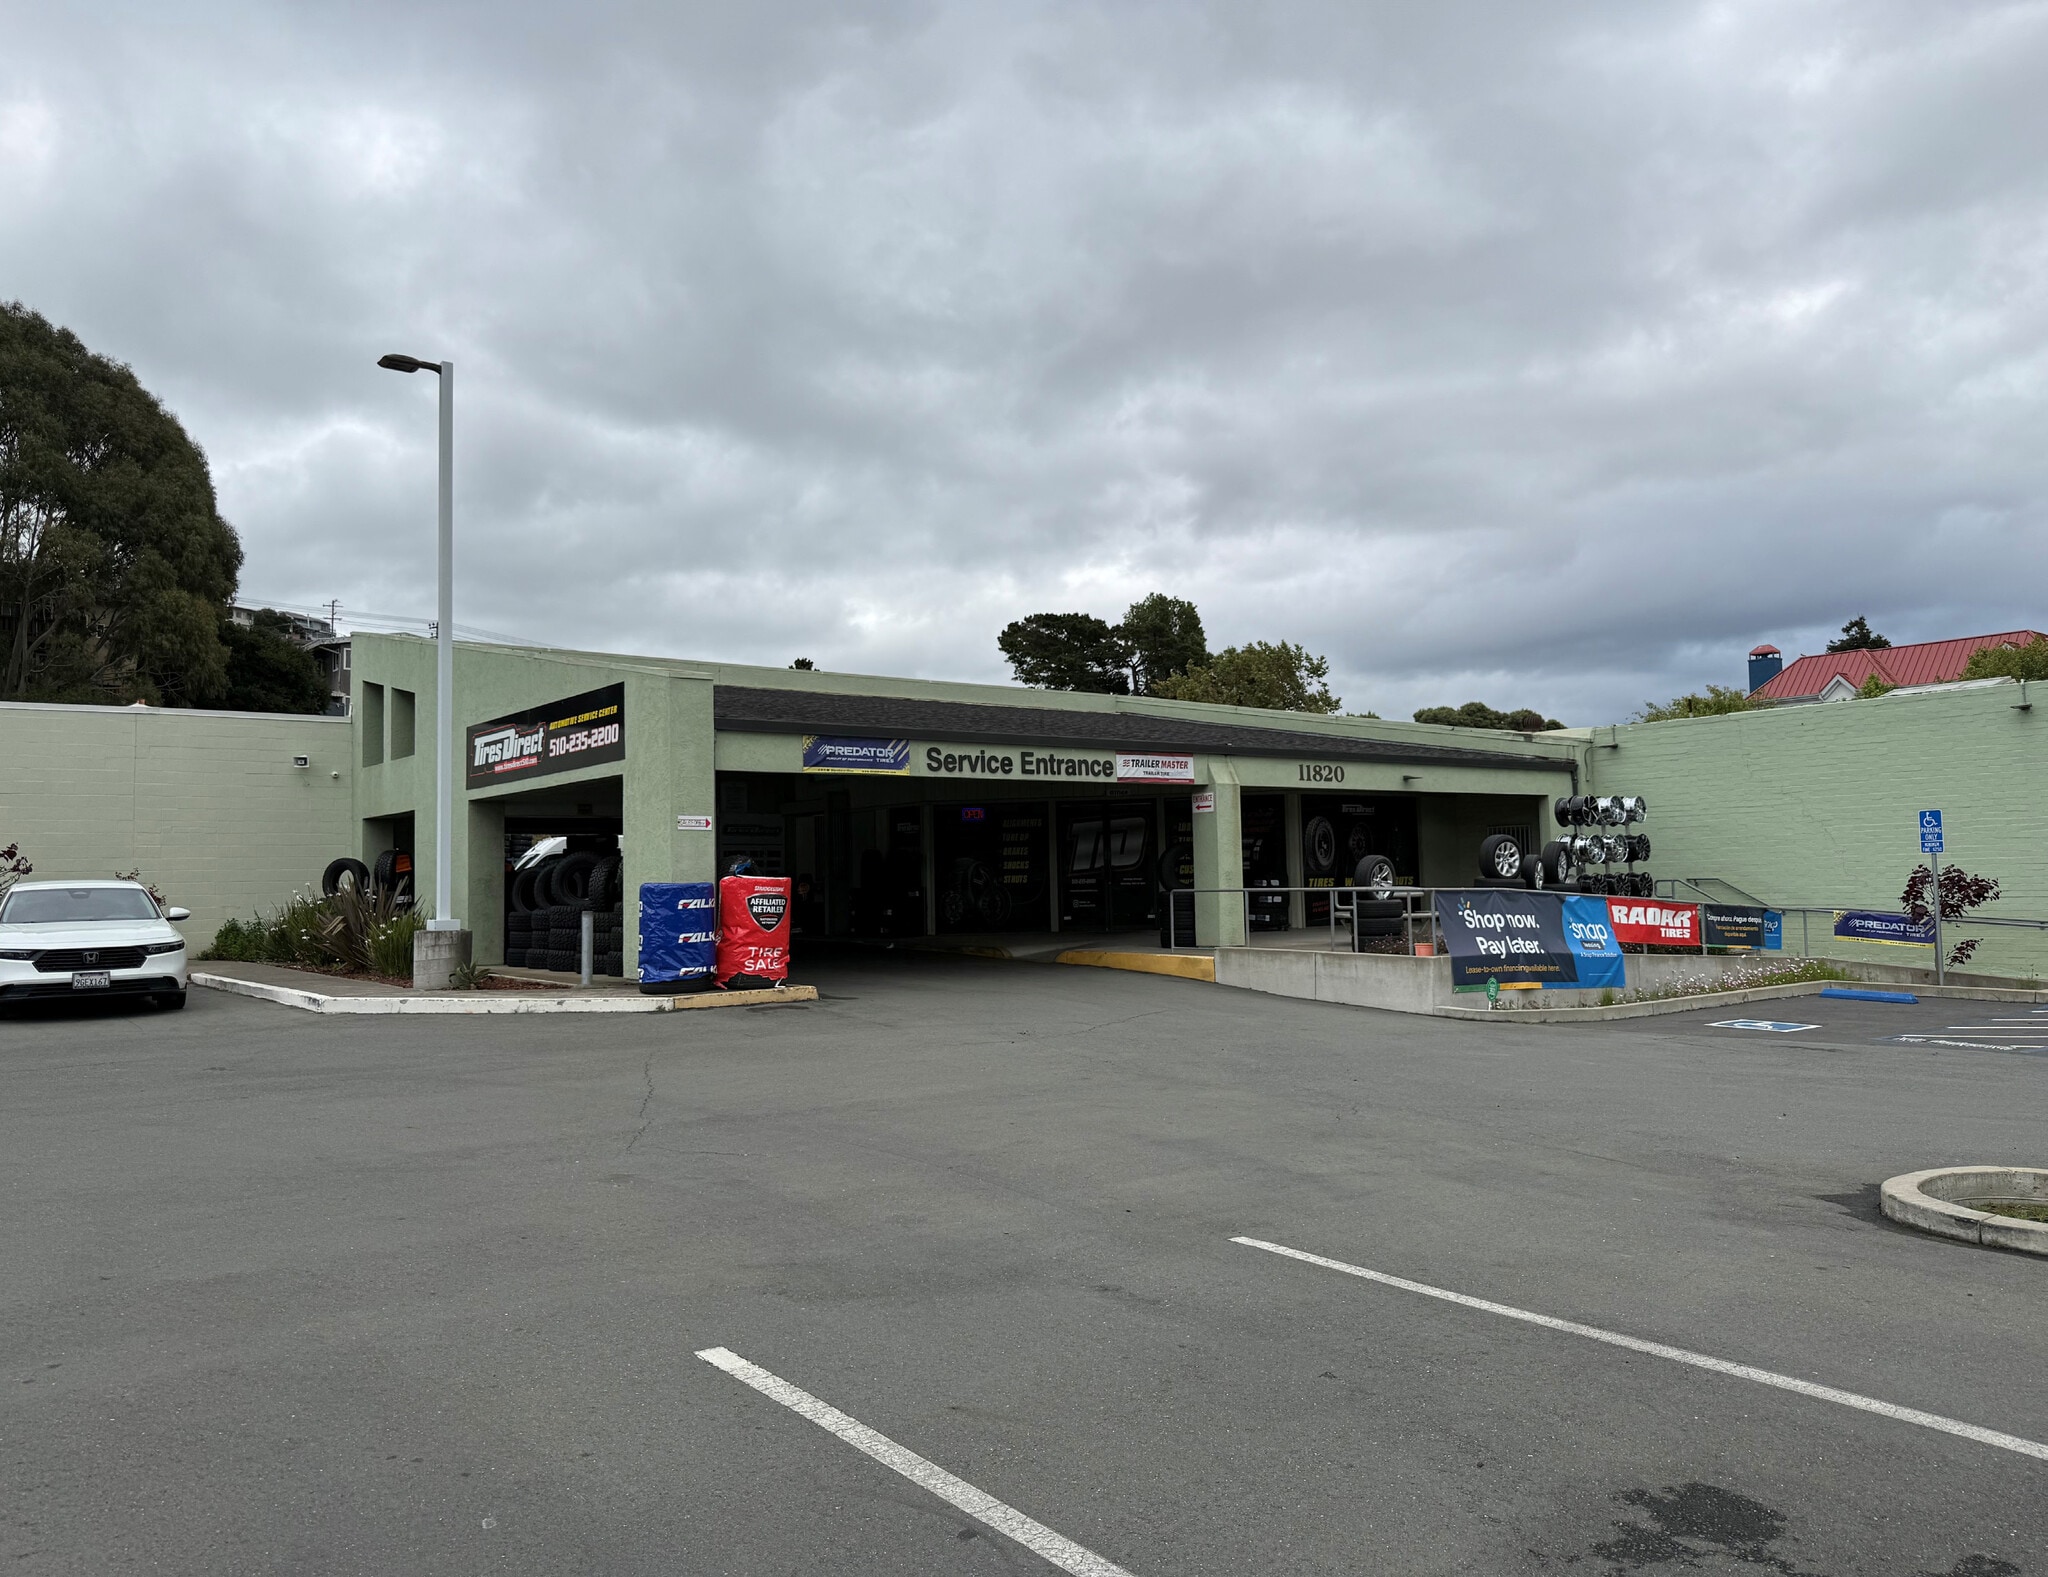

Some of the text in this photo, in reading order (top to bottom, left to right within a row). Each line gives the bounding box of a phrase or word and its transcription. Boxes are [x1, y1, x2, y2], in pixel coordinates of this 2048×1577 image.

[577, 710, 598, 723] SERVICE
[598, 705, 618, 719] CENTER
[549, 724, 619, 757] 510-235-2200
[826, 745, 894, 758] PREDATOR
[926, 747, 1114, 777] Service Entrance
[1131, 759, 1188, 769] TRAILER MASTER
[1298, 764, 1345, 783] 11820
[1193, 794, 1213, 803] ENTRANCE
[1003, 861, 1029, 869] SHOCKS
[1179, 865, 1194, 874] CUS
[1003, 875, 1028, 883] STRUTS
[1309, 878, 1335, 887] TIRES
[1464, 909, 1540, 932] Shop now.
[1611, 905, 1692, 928] RADAR
[1856, 919, 1925, 932] PREDATOR
[1572, 922, 1608, 946] snap
[1660, 928, 1690, 938] TIRES
[748, 946, 782, 958] TIRE
[1476, 936, 1545, 959] Pay later.
[745, 958, 781, 971] SALE
[1465, 965, 1502, 974] Lease-to-own
[75, 977, 107, 986] 9GEX167
